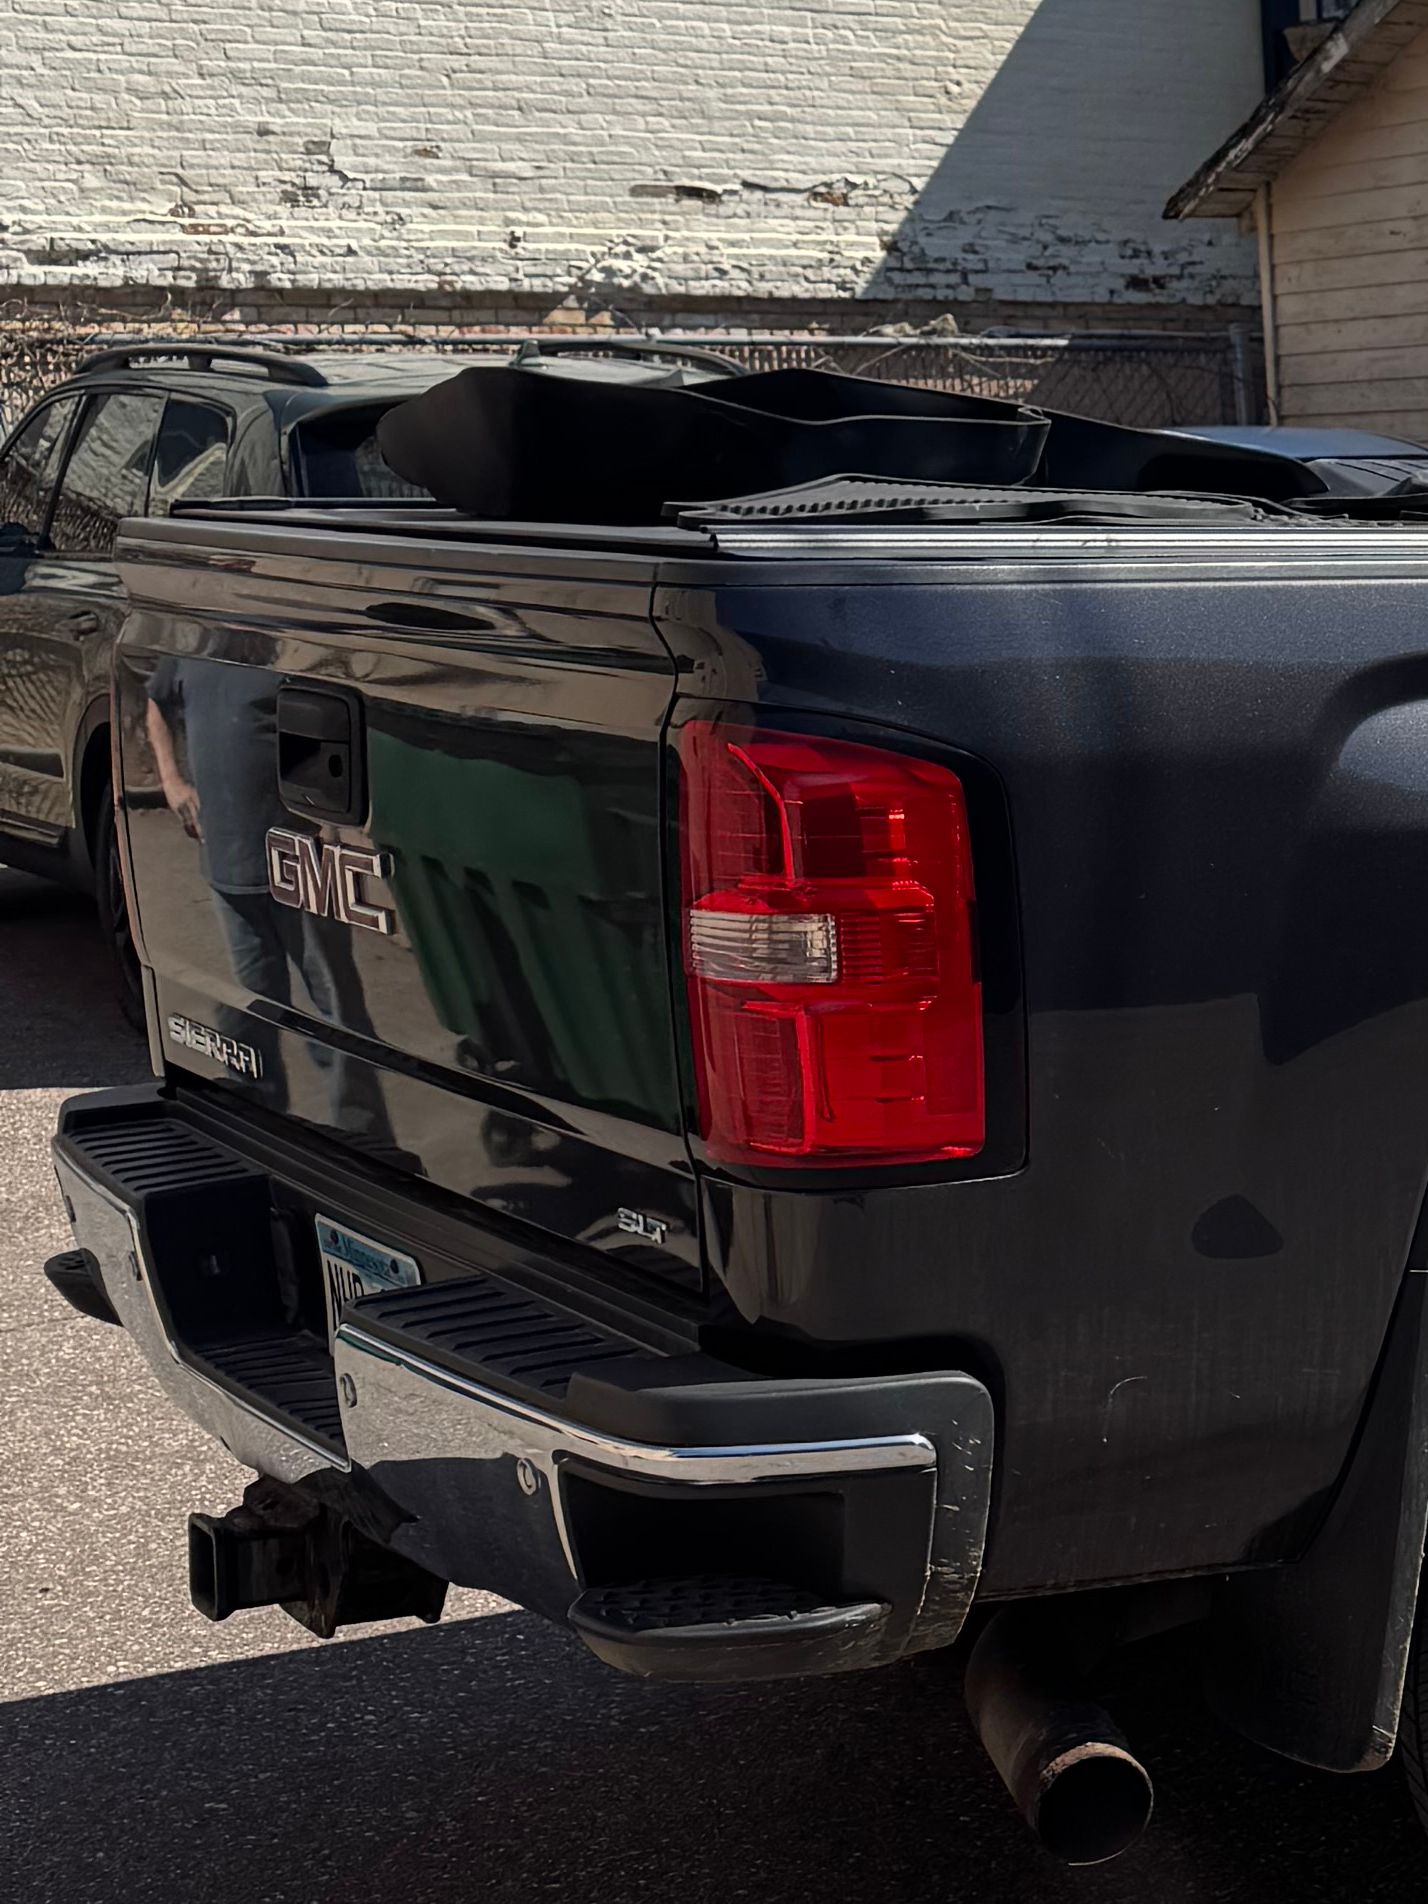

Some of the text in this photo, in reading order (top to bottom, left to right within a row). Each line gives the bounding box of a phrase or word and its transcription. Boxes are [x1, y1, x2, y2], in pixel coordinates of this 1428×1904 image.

[265, 827, 394, 936] GMC
[168, 1014, 261, 1080] SIERRA
[617, 1207, 667, 1245] SLT
